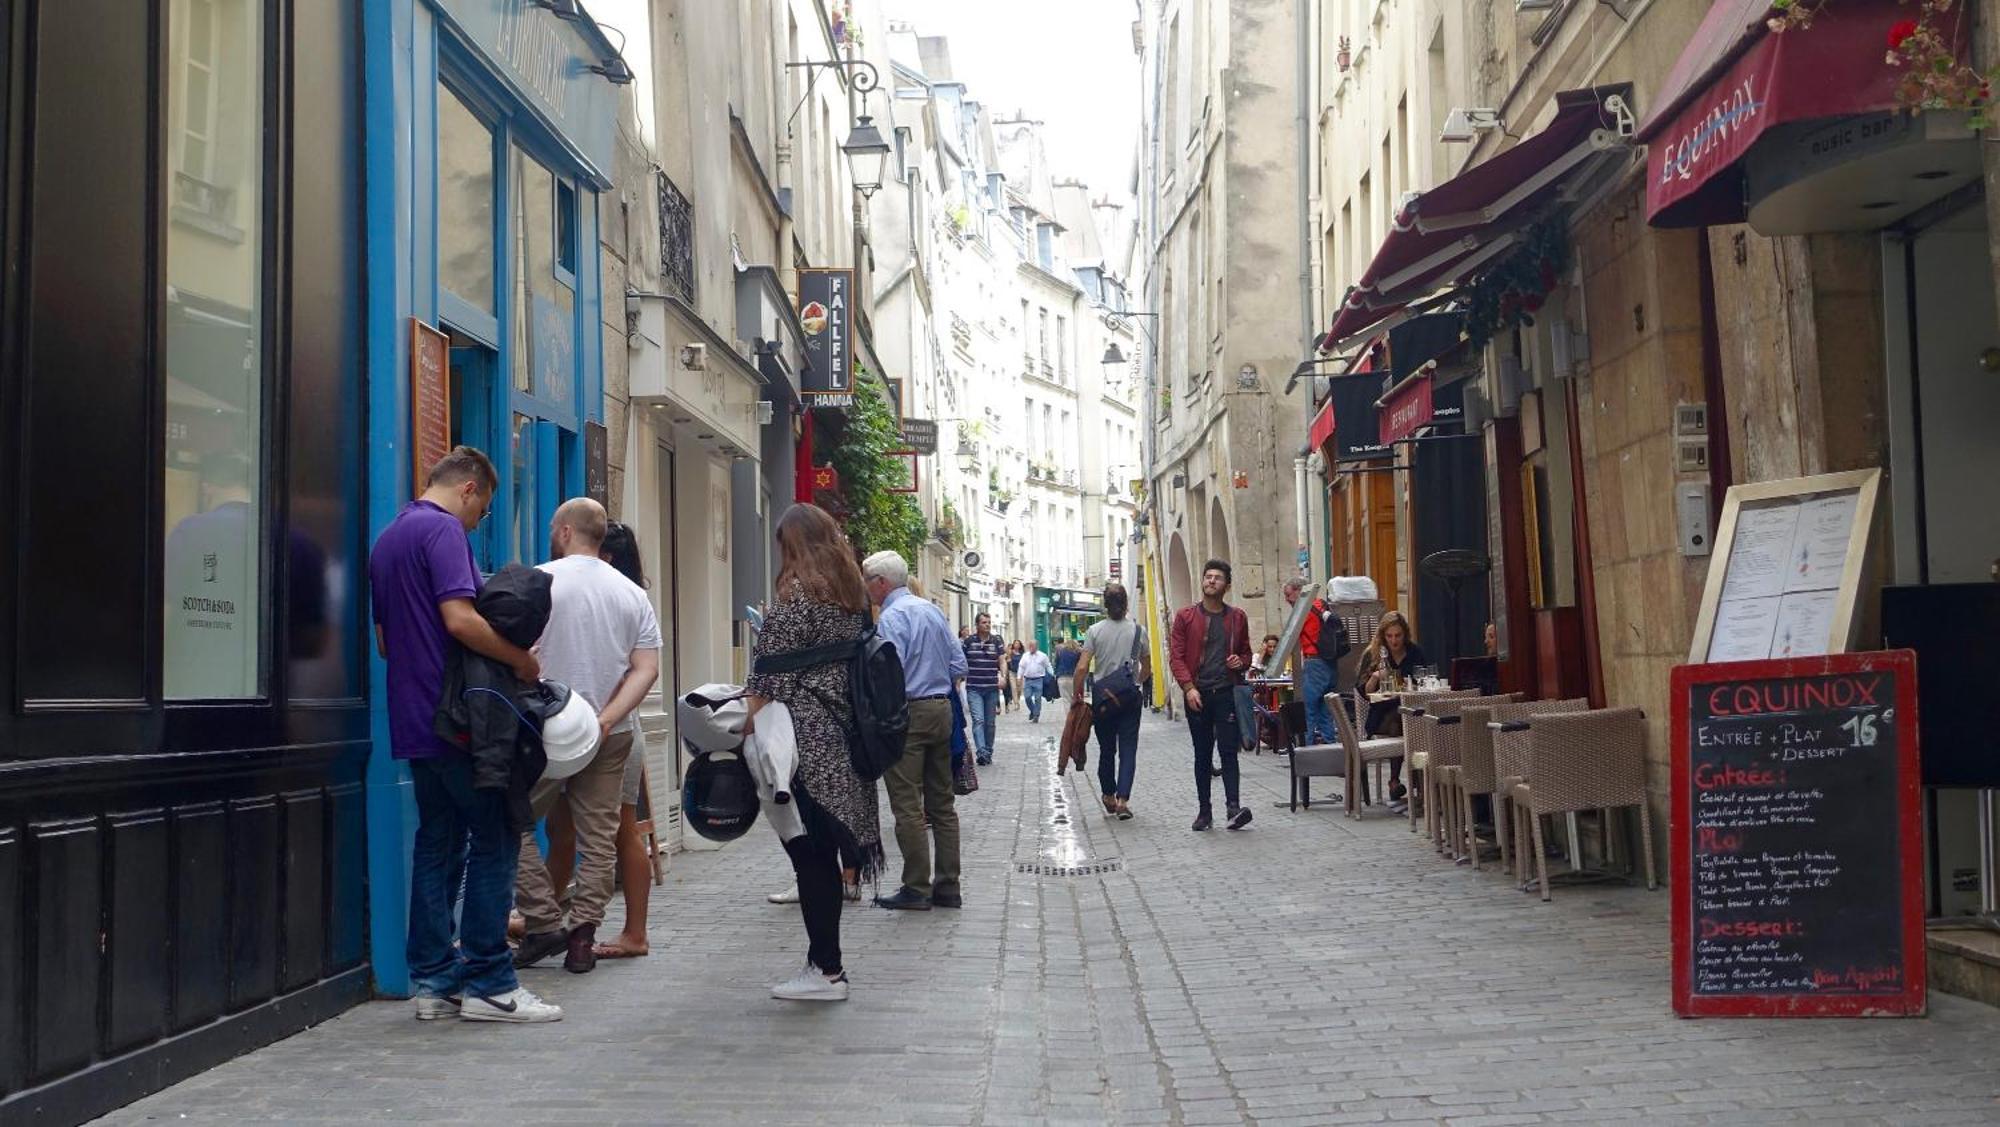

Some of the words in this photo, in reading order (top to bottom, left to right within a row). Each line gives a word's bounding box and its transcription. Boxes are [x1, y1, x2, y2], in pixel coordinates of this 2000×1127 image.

[1663, 74, 1756, 184] EQUINOX
[1862, 118, 1893, 138] bar
[814, 394, 853, 406] HANNA
[1709, 678, 1882, 716] EQUINOX
[1782, 723, 1822, 743] PLAT
[1782, 747, 1847, 761] DESSERT
